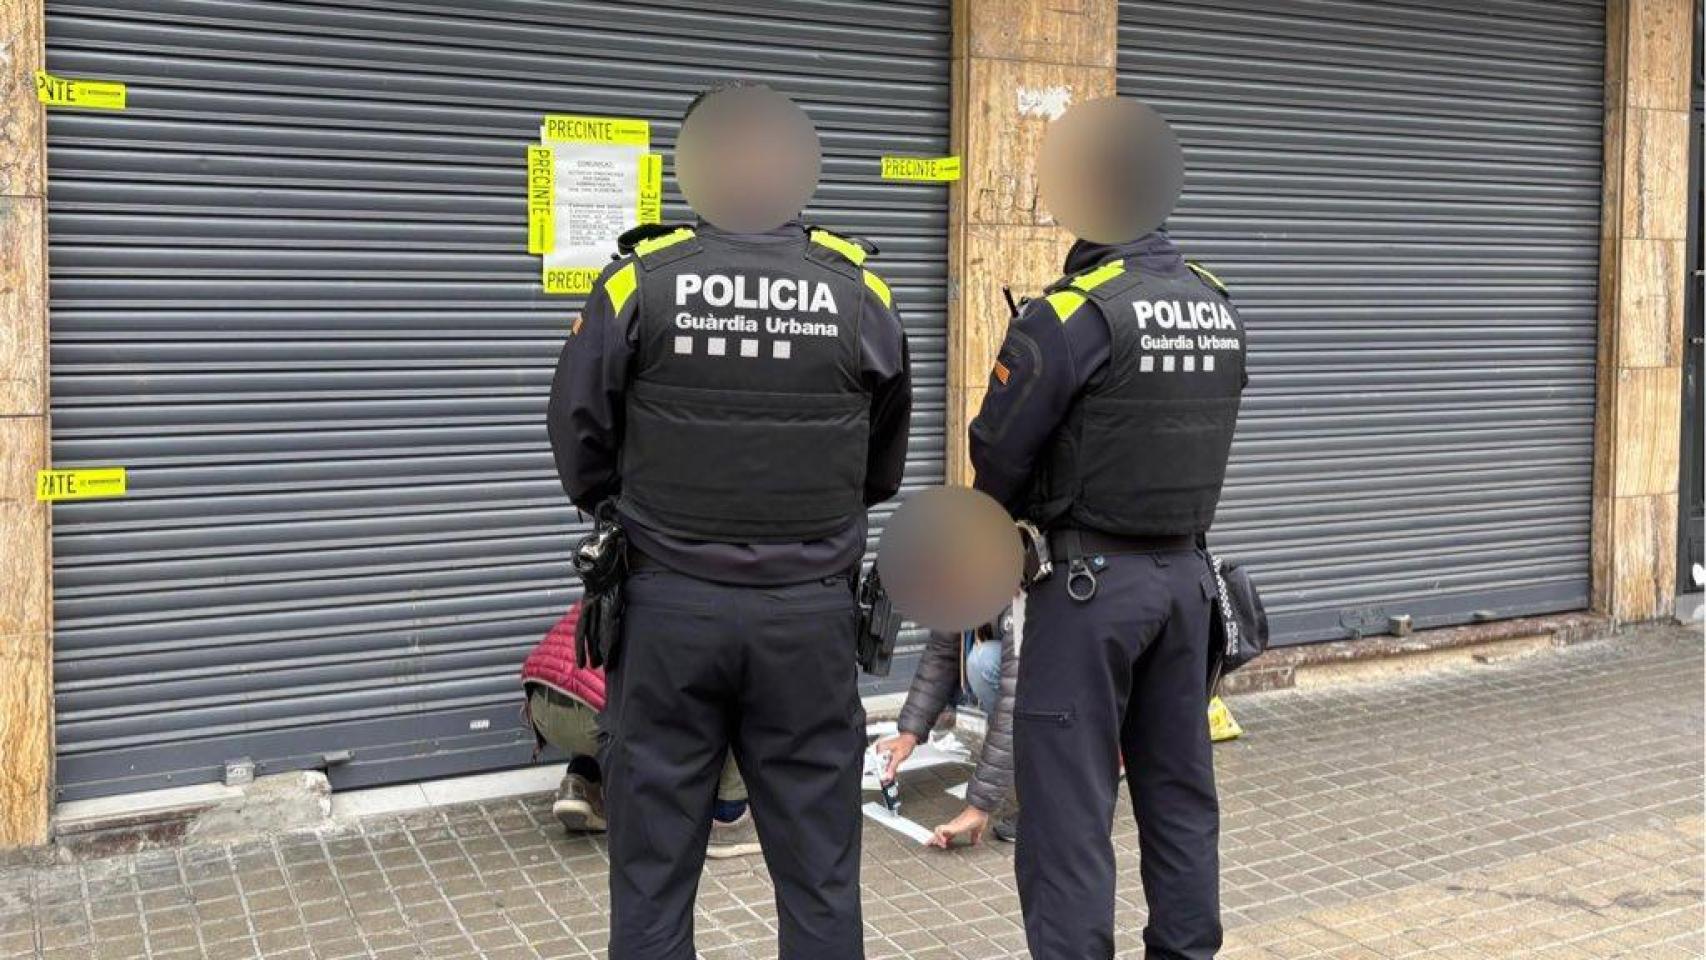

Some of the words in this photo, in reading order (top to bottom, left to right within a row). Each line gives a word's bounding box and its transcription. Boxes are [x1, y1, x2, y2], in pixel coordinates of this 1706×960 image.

[548, 119, 613, 141] PRECINTE
[884, 159, 937, 178] PRECINTE
[532, 149, 551, 216] PRECINTE
[547, 270, 599, 290] PRECIN
[675, 273, 839, 314] POLICIA
[675, 312, 759, 333] Guàrdia
[765, 316, 839, 337] Urbana
[1132, 300, 1237, 330] POLICIA
[1140, 334, 1194, 350] Guàrdia
[1197, 334, 1240, 350] Urbana
